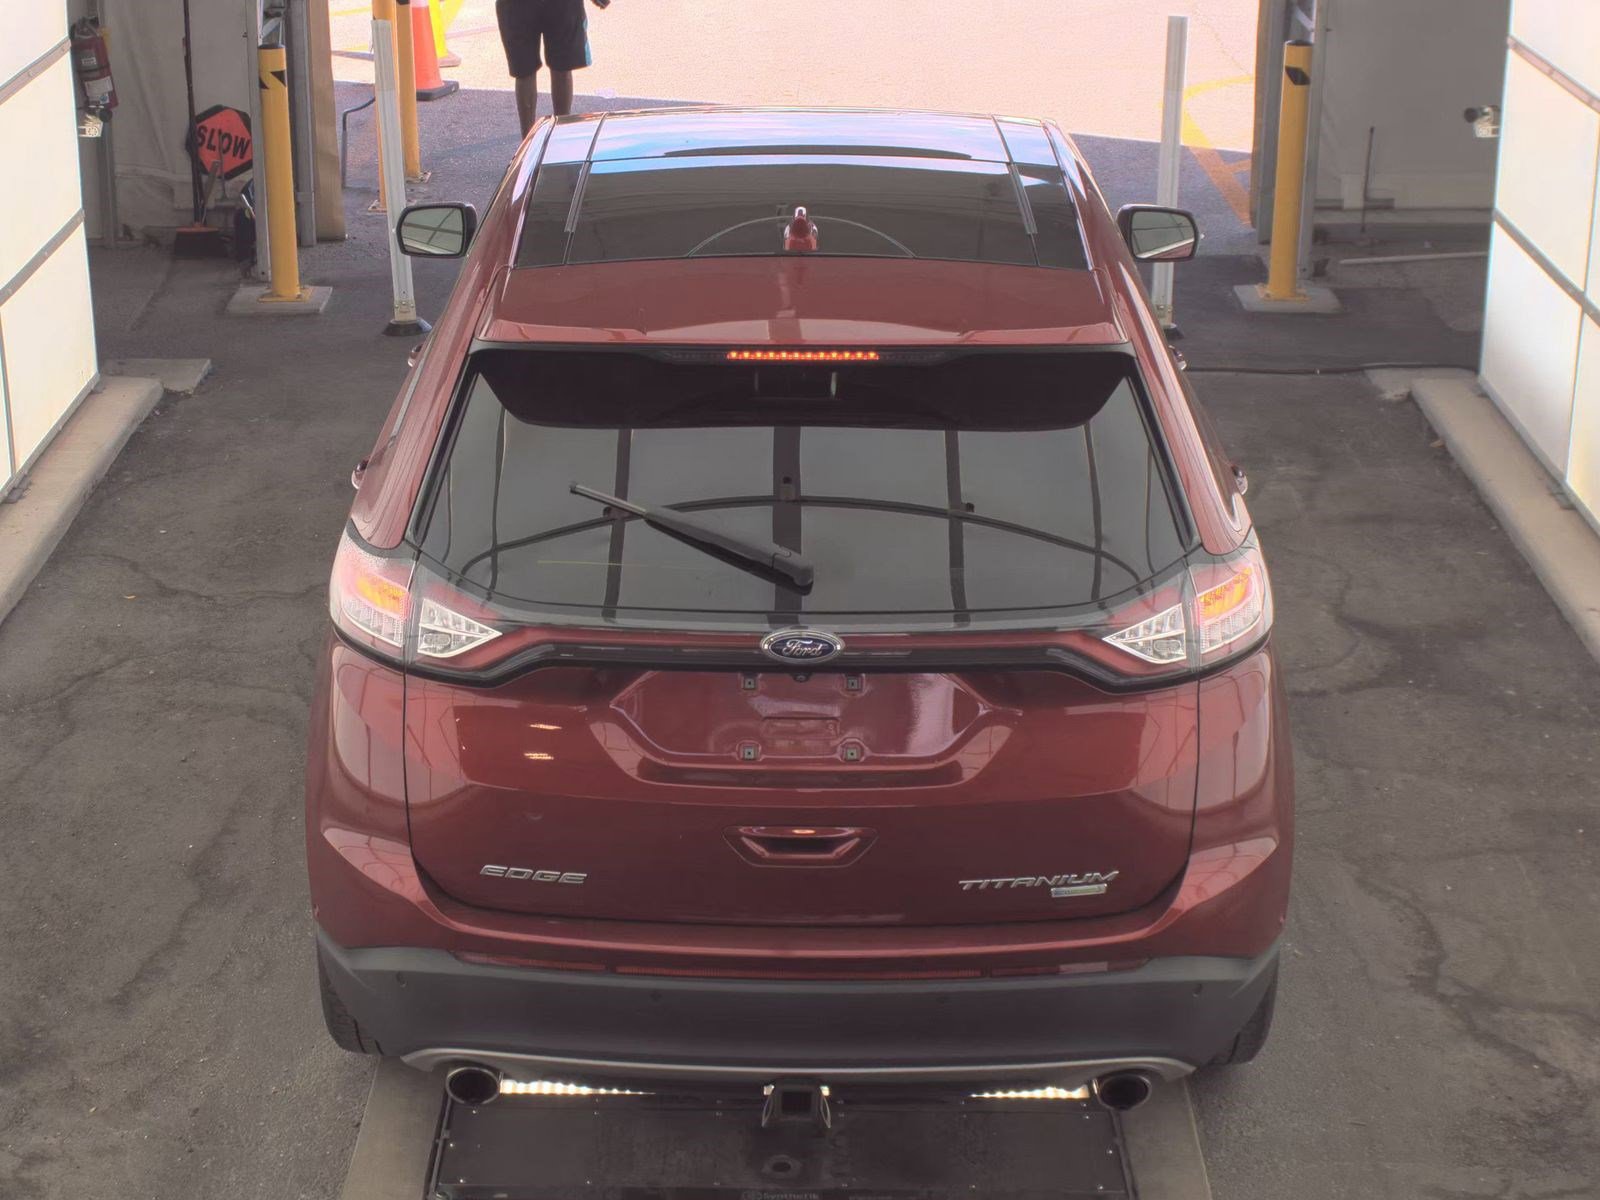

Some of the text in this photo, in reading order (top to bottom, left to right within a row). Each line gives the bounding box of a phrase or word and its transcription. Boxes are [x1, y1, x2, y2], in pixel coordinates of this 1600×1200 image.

[196, 125, 250, 160] SLOW
[782, 638, 823, 656] Ford
[480, 864, 588, 884] EDGE
[958, 870, 1119, 890] TITANIUM
